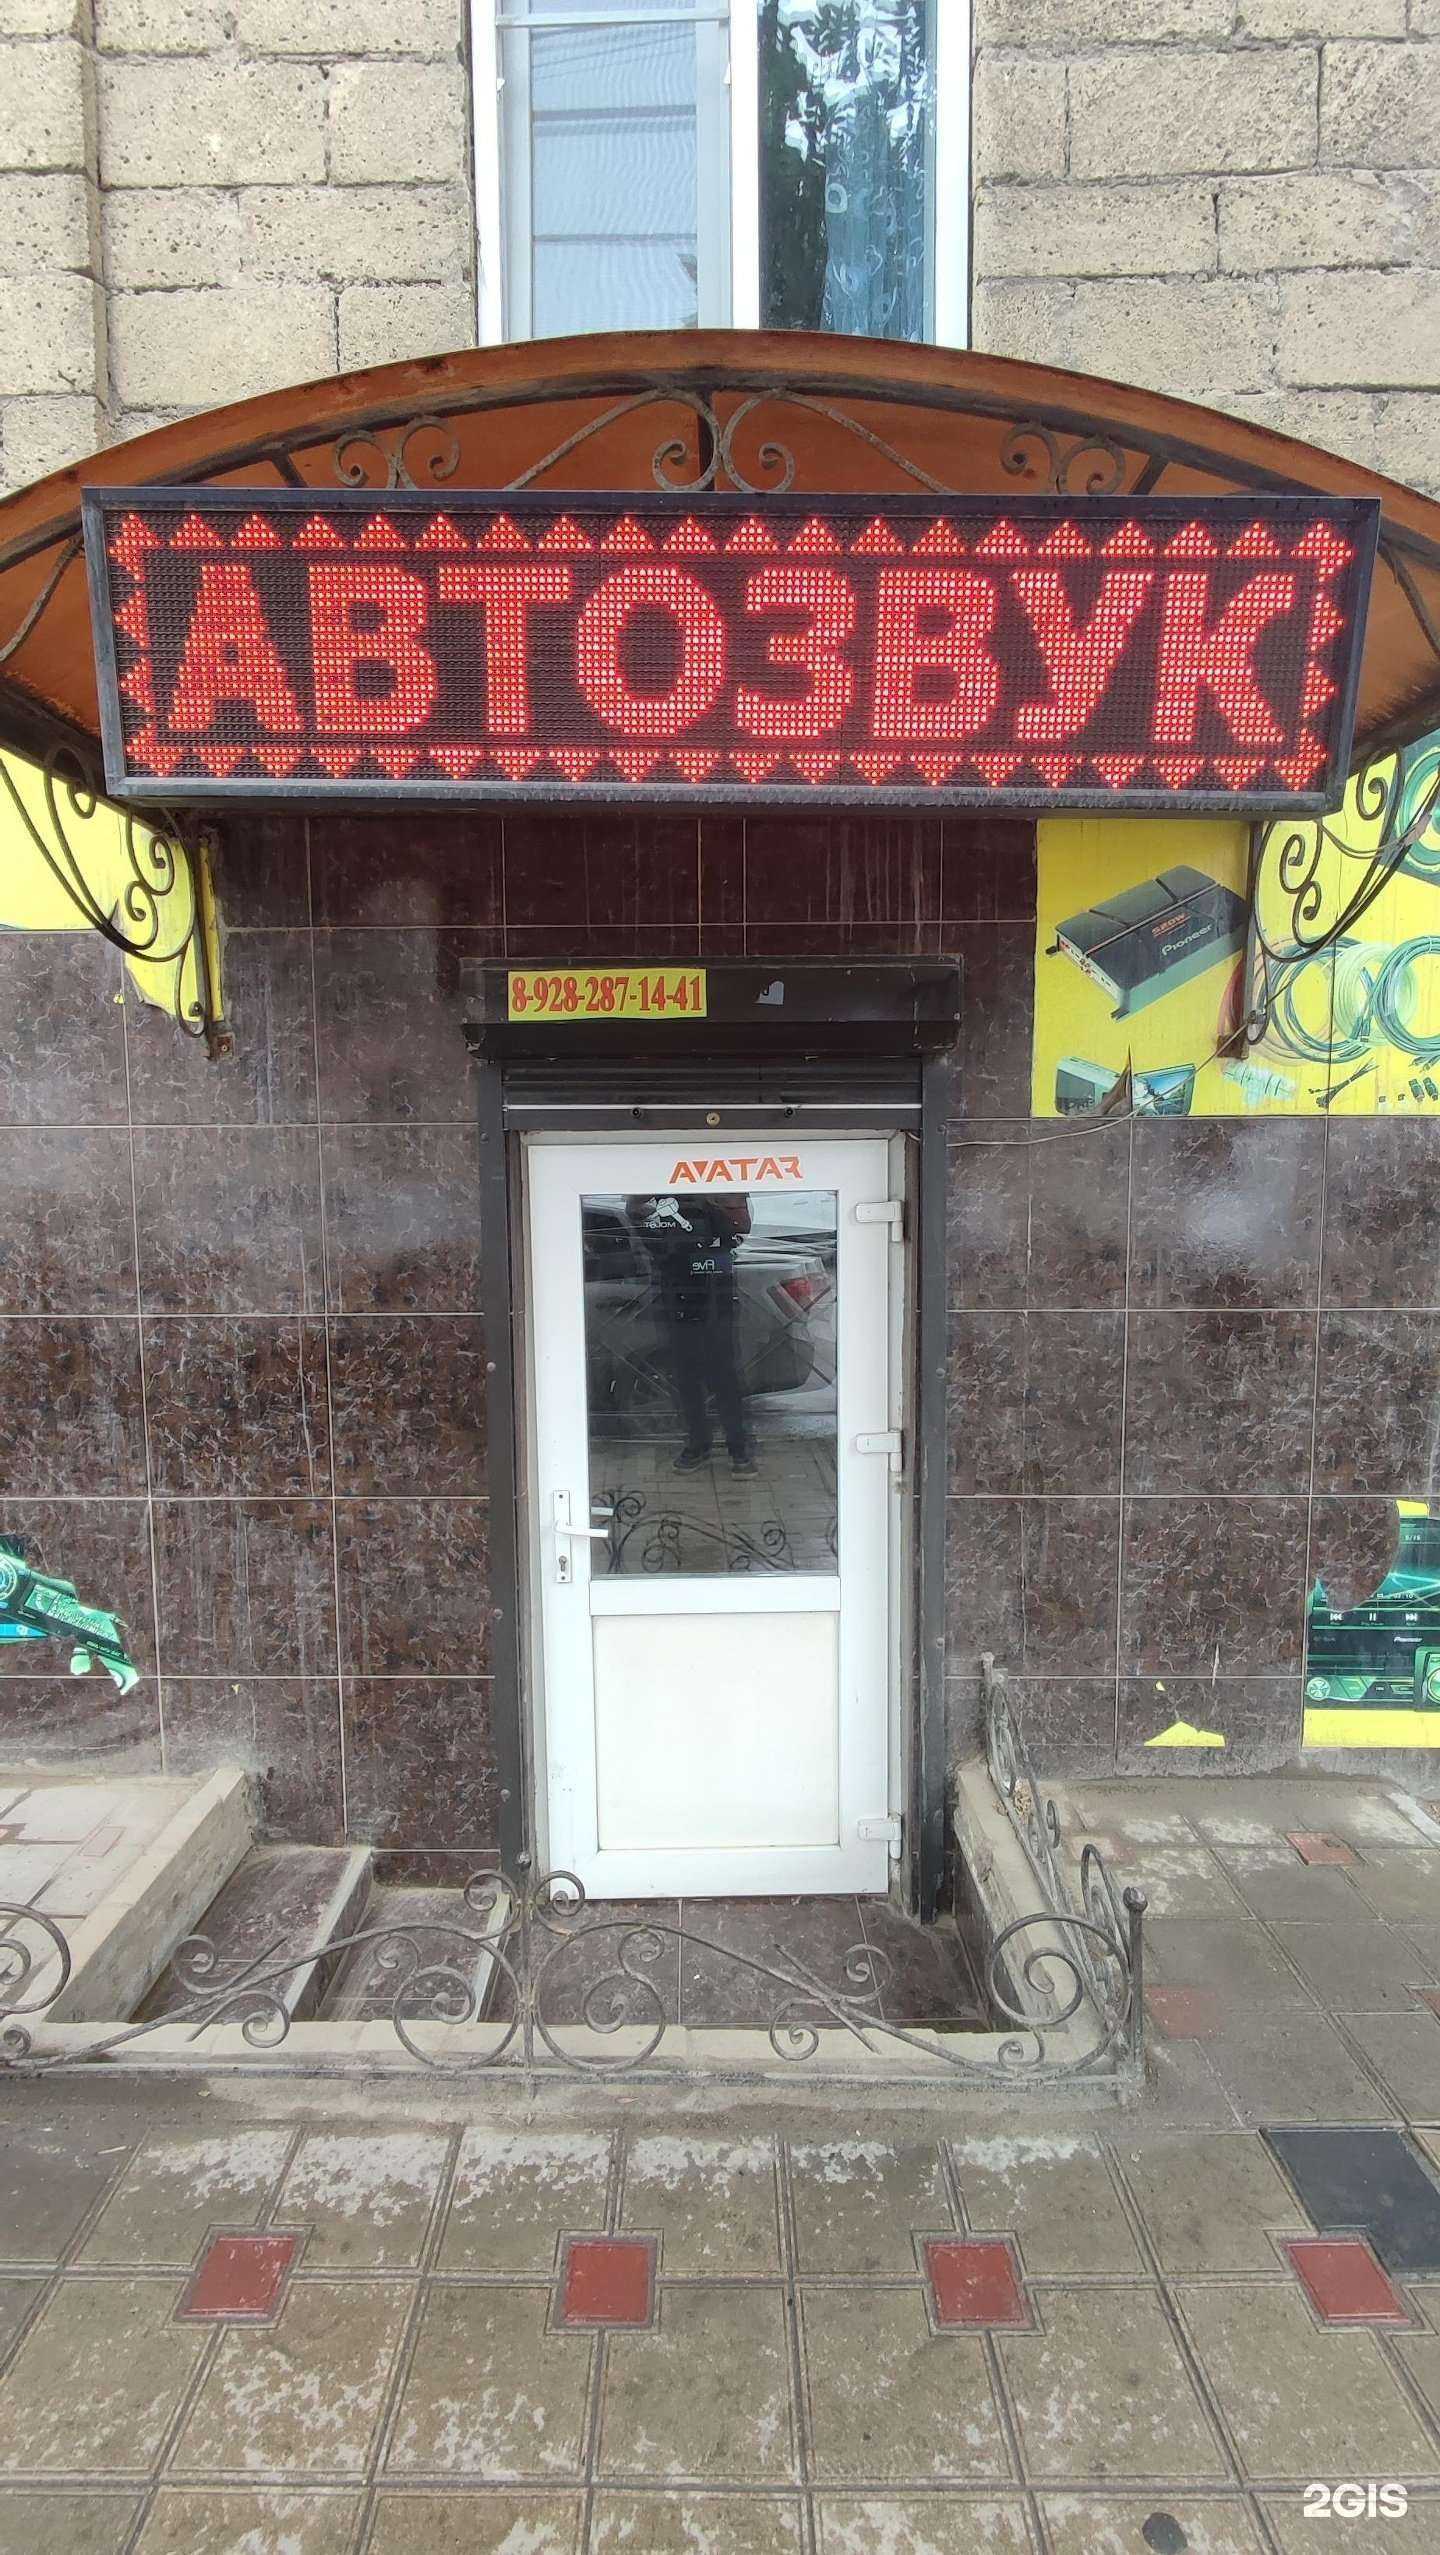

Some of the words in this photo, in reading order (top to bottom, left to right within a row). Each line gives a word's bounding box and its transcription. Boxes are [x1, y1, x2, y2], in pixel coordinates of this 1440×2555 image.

[168, 563, 1296, 744] АВТОЗВУК
[1161, 924, 1213, 956] Pioneer
[511, 975, 703, 1013] 8-928-287-14-41
[669, 1156, 804, 1184] AVATAR
